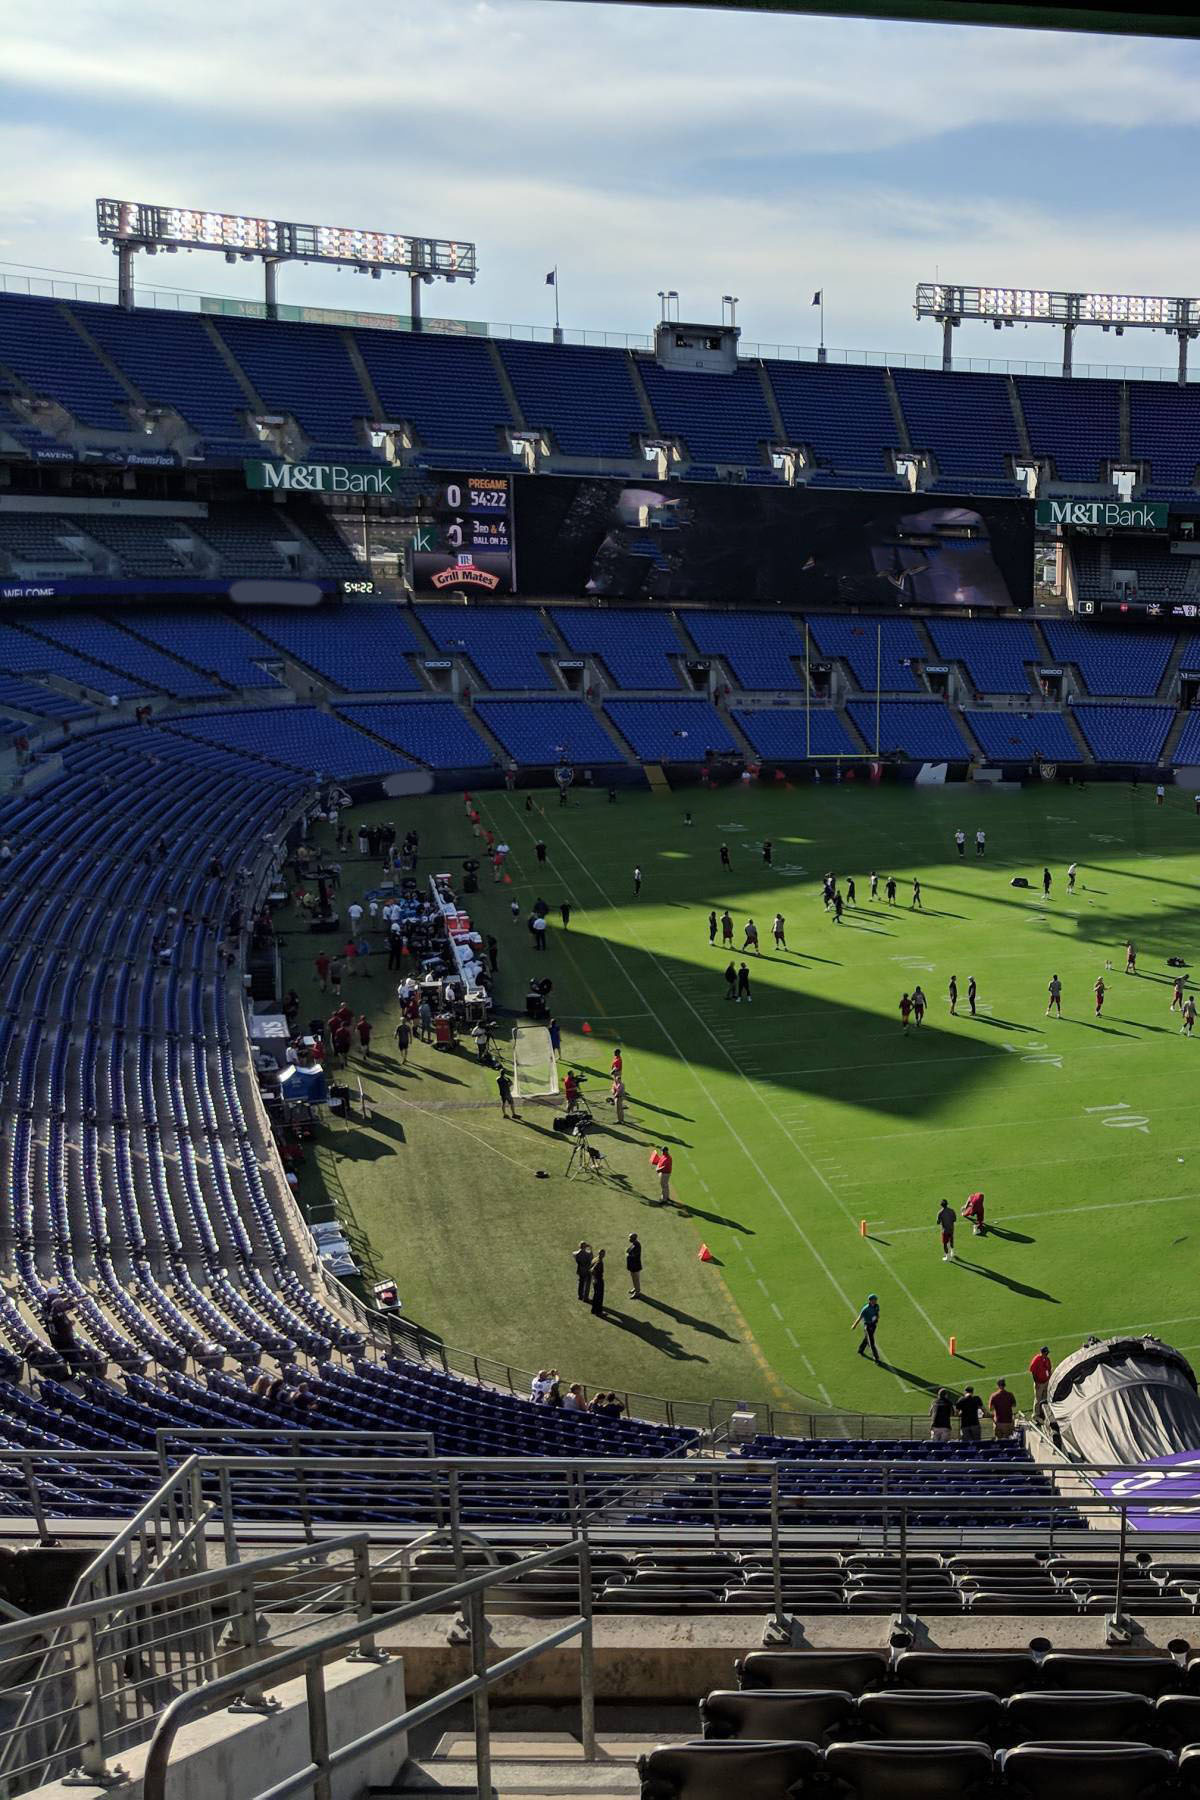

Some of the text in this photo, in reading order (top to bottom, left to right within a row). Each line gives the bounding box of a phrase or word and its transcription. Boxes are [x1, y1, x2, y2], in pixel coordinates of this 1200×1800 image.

[37, 451, 74, 460] RAVENS
[127, 454, 175, 466] #RavensFlock
[262, 462, 393, 493] M&T Bank
[468, 478, 508, 490] PREGAME
[447, 484, 461, 507] 0
[470, 491, 507, 507] 54:22
[1049, 501, 1156, 526] M&T Bank
[473, 521, 489, 534] 3RD
[498, 521, 506, 534] 4
[473, 536, 508, 545] BALL ON 25
[436, 571, 494, 586] Grill Mates
[344, 581, 374, 593] 54:22
[425, 660, 451, 668] GEICO
[559, 660, 583, 668] GEICO
[1040, 668, 1063, 676] GEICO
